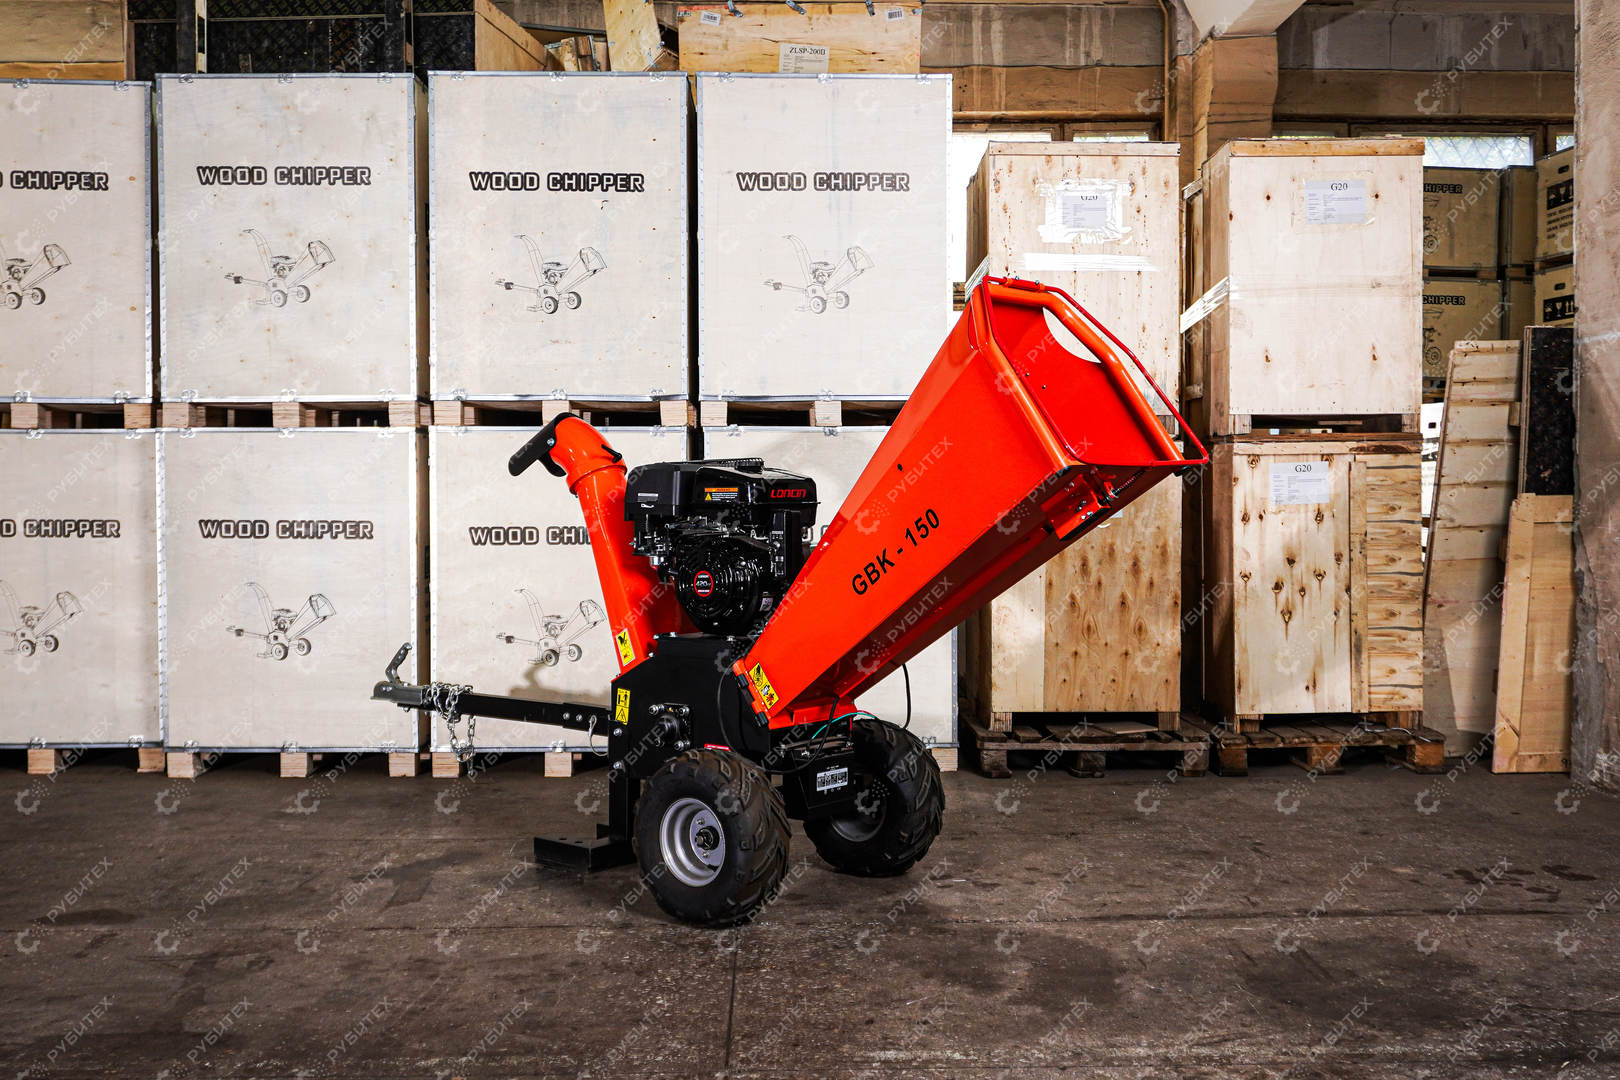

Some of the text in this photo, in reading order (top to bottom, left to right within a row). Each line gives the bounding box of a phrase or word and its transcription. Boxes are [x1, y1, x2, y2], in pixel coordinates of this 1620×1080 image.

[10, 170, 109, 191] CHIPPER
[196, 166, 371, 186] WOOD CHIPPER
[469, 172, 645, 192] WOOD CHIPPER
[736, 172, 910, 192] WOOD CHIPPER
[1330, 182, 1348, 191] G20
[1423, 183, 1462, 194] HIPPER
[1294, 464, 1312, 473] G20
[24, 519, 120, 538] CHIPPER
[199, 520, 374, 539] WOOD CHIPPER
[469, 526, 591, 545] WOOD CHI
[852, 548, 895, 595] GBK
[905, 508, 940, 547] 150
